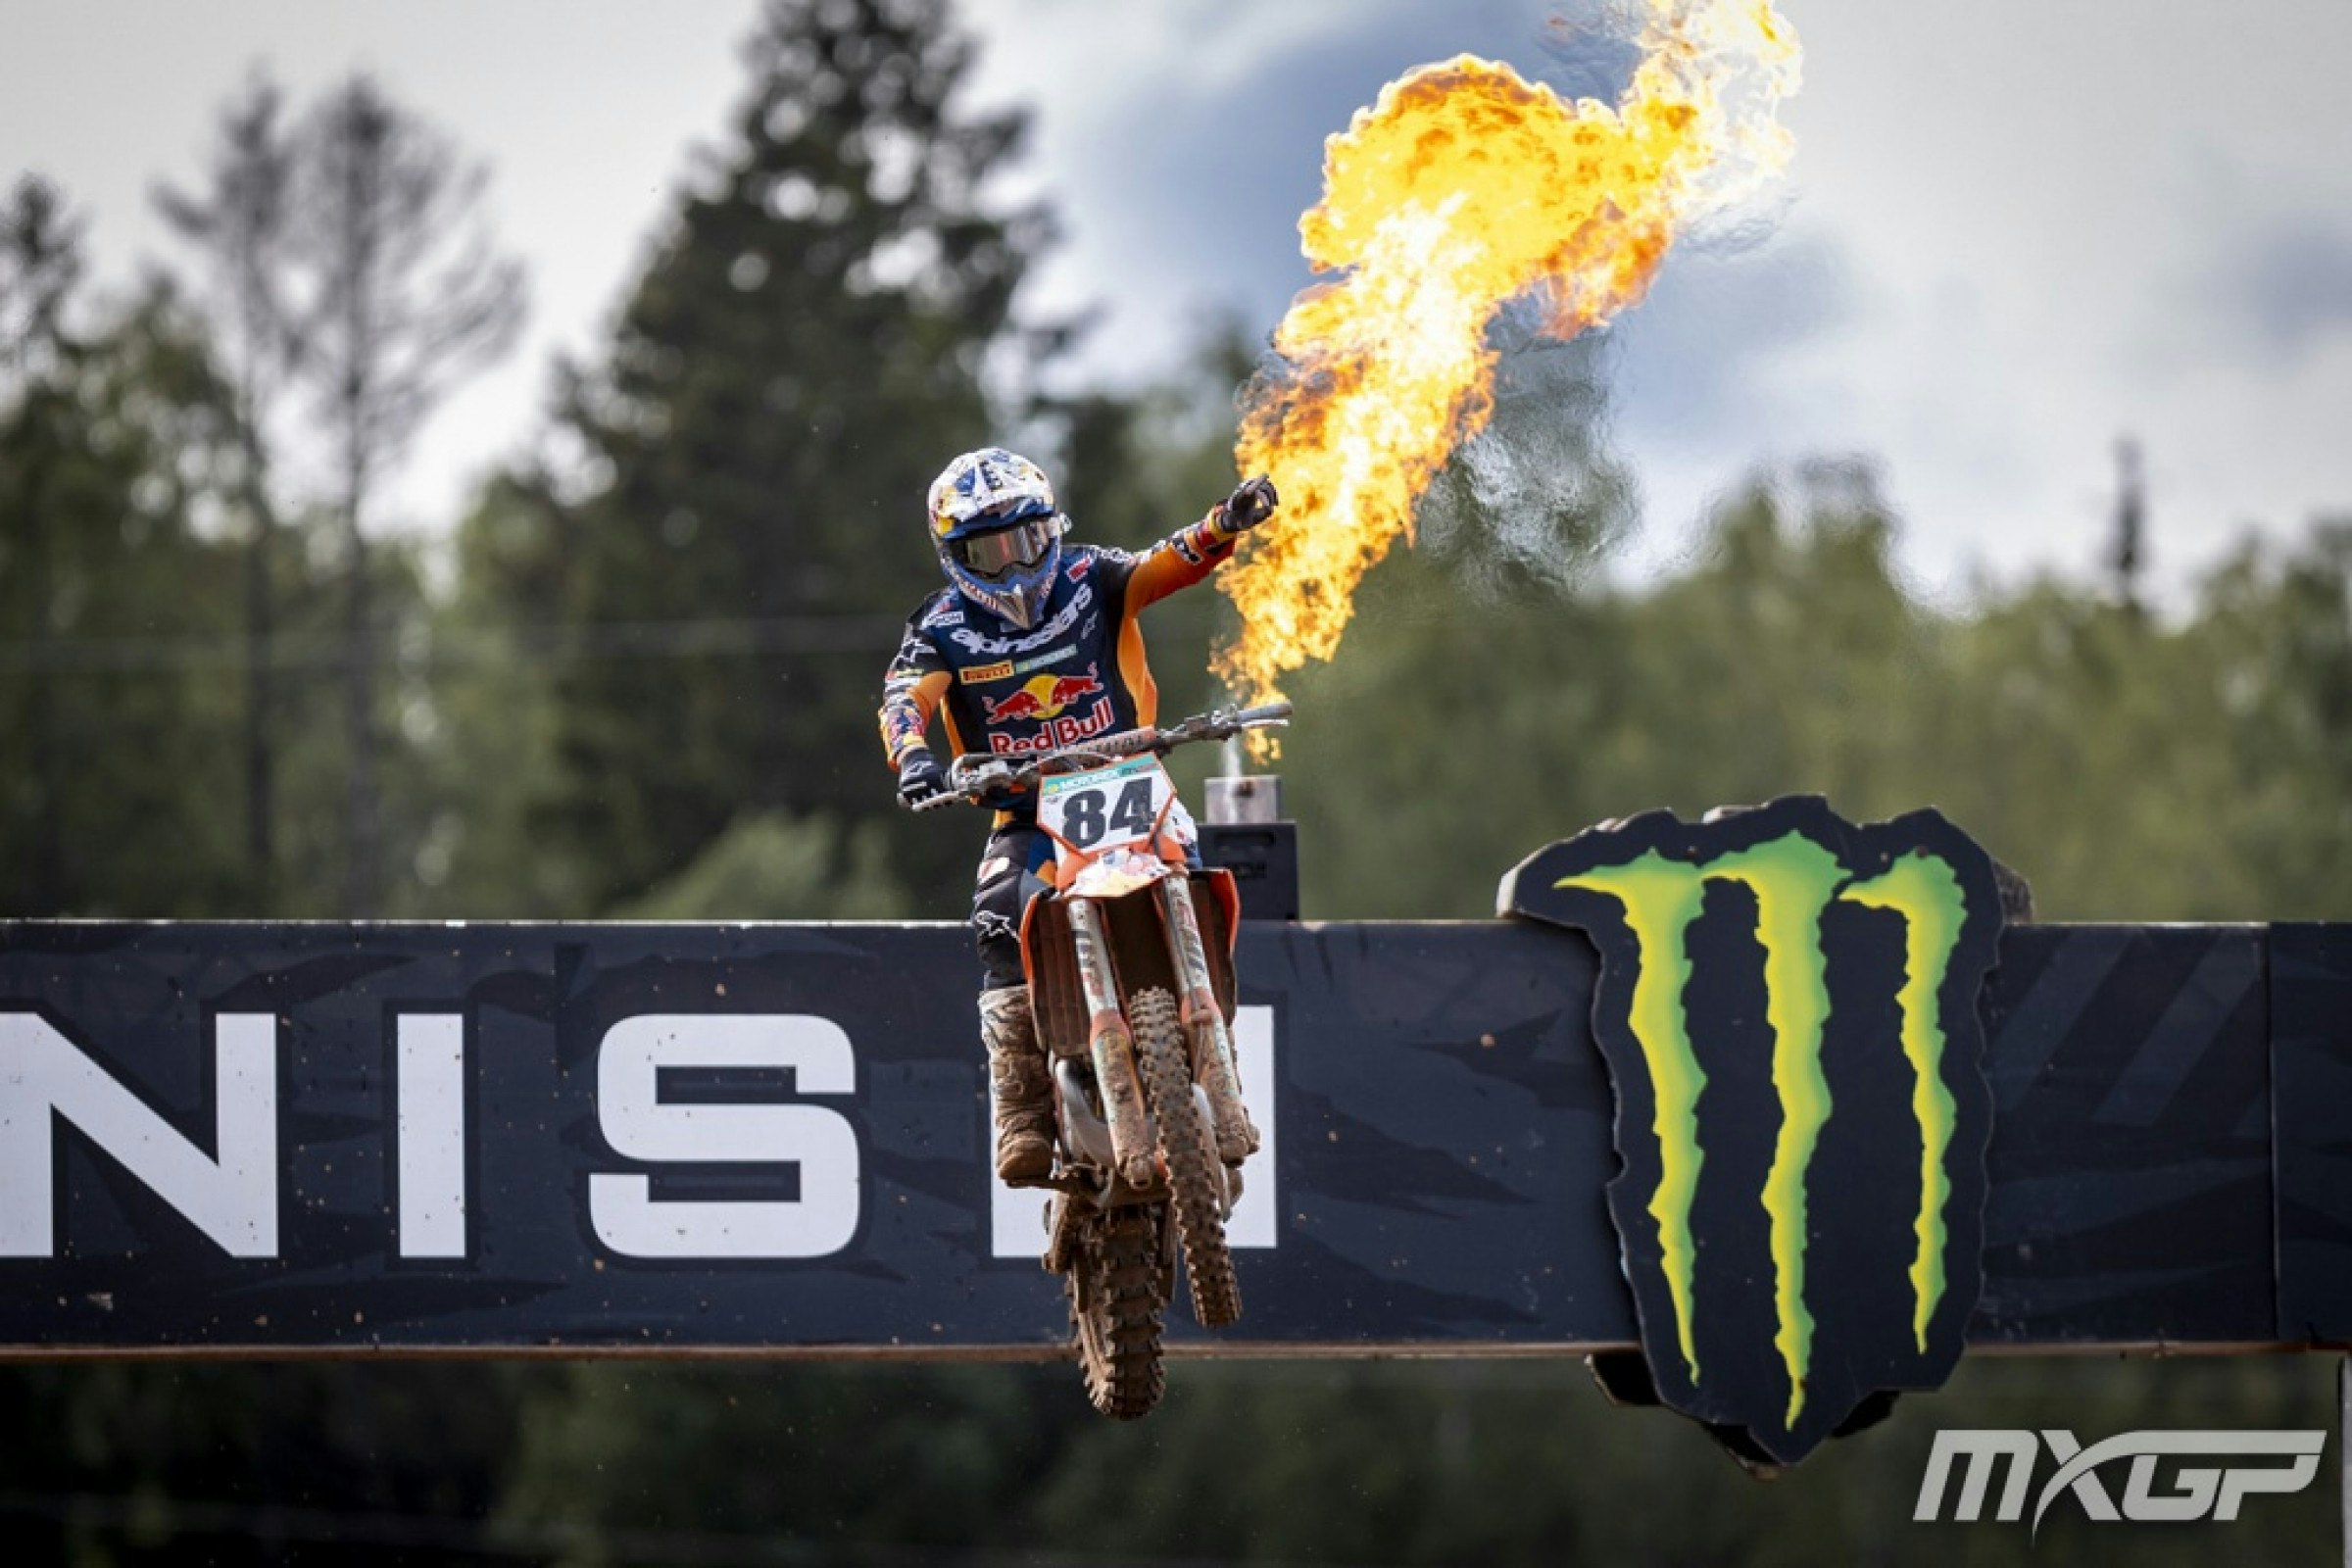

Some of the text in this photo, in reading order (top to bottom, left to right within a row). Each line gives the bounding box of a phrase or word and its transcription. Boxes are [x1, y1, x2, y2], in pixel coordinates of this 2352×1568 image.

[990, 721, 1055, 754] Red
[1054, 696, 1115, 746] Bull
[1061, 777, 1156, 849] 84
